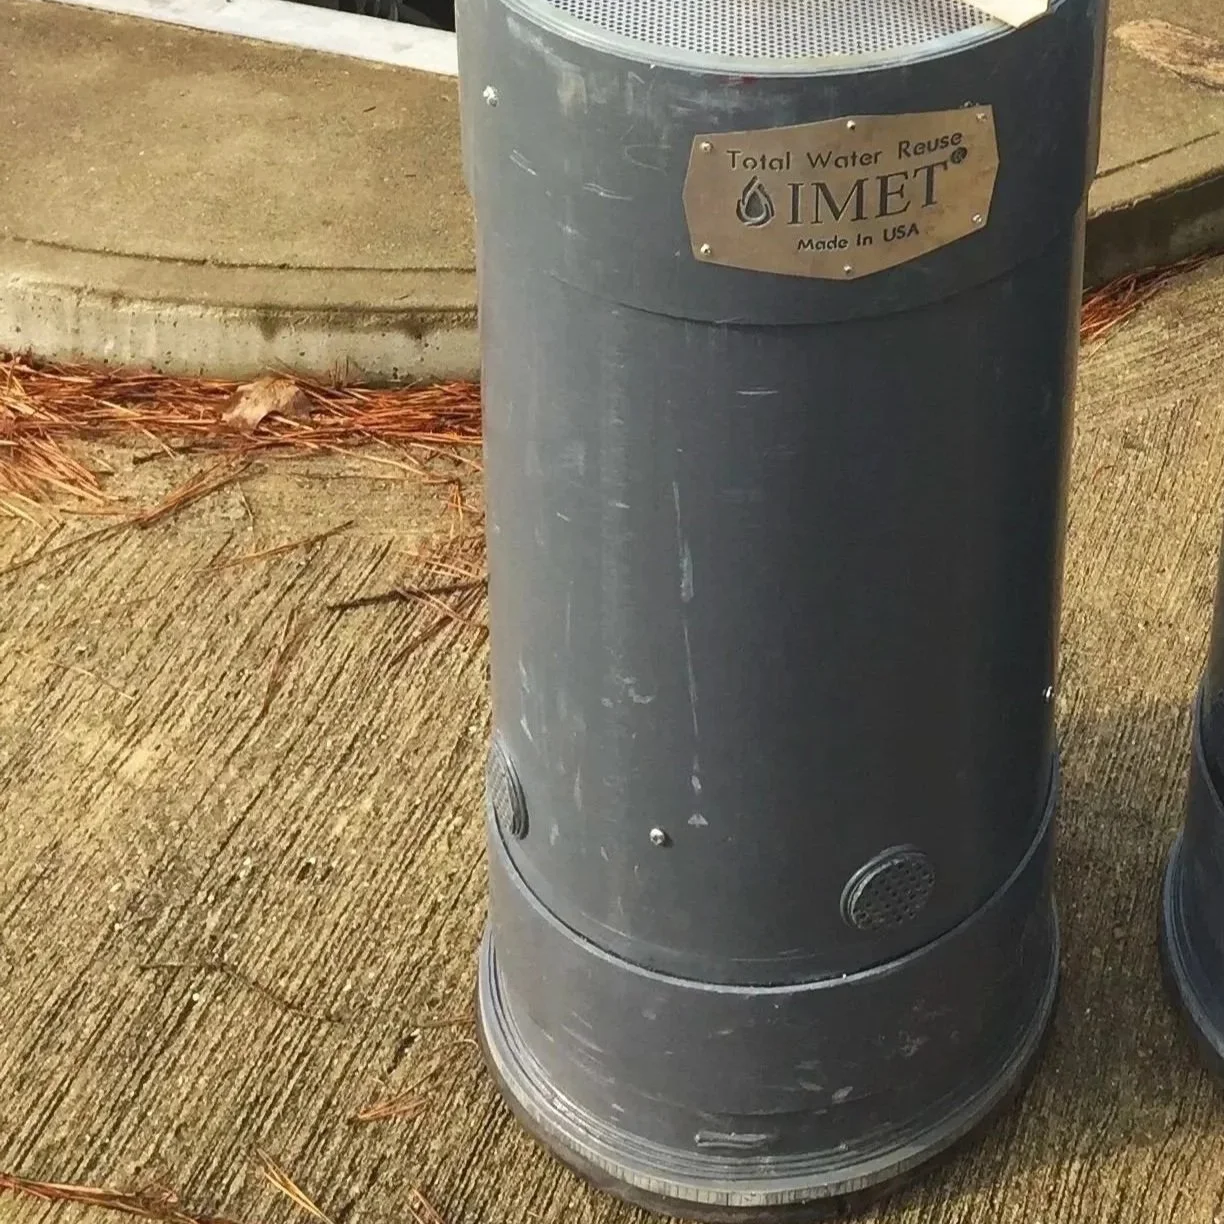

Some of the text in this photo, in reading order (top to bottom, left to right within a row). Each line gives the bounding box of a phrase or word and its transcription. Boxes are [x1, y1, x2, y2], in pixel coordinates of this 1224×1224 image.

[727, 131, 963, 172] Total Water Reuse
[797, 224, 919, 252] Made In USA
